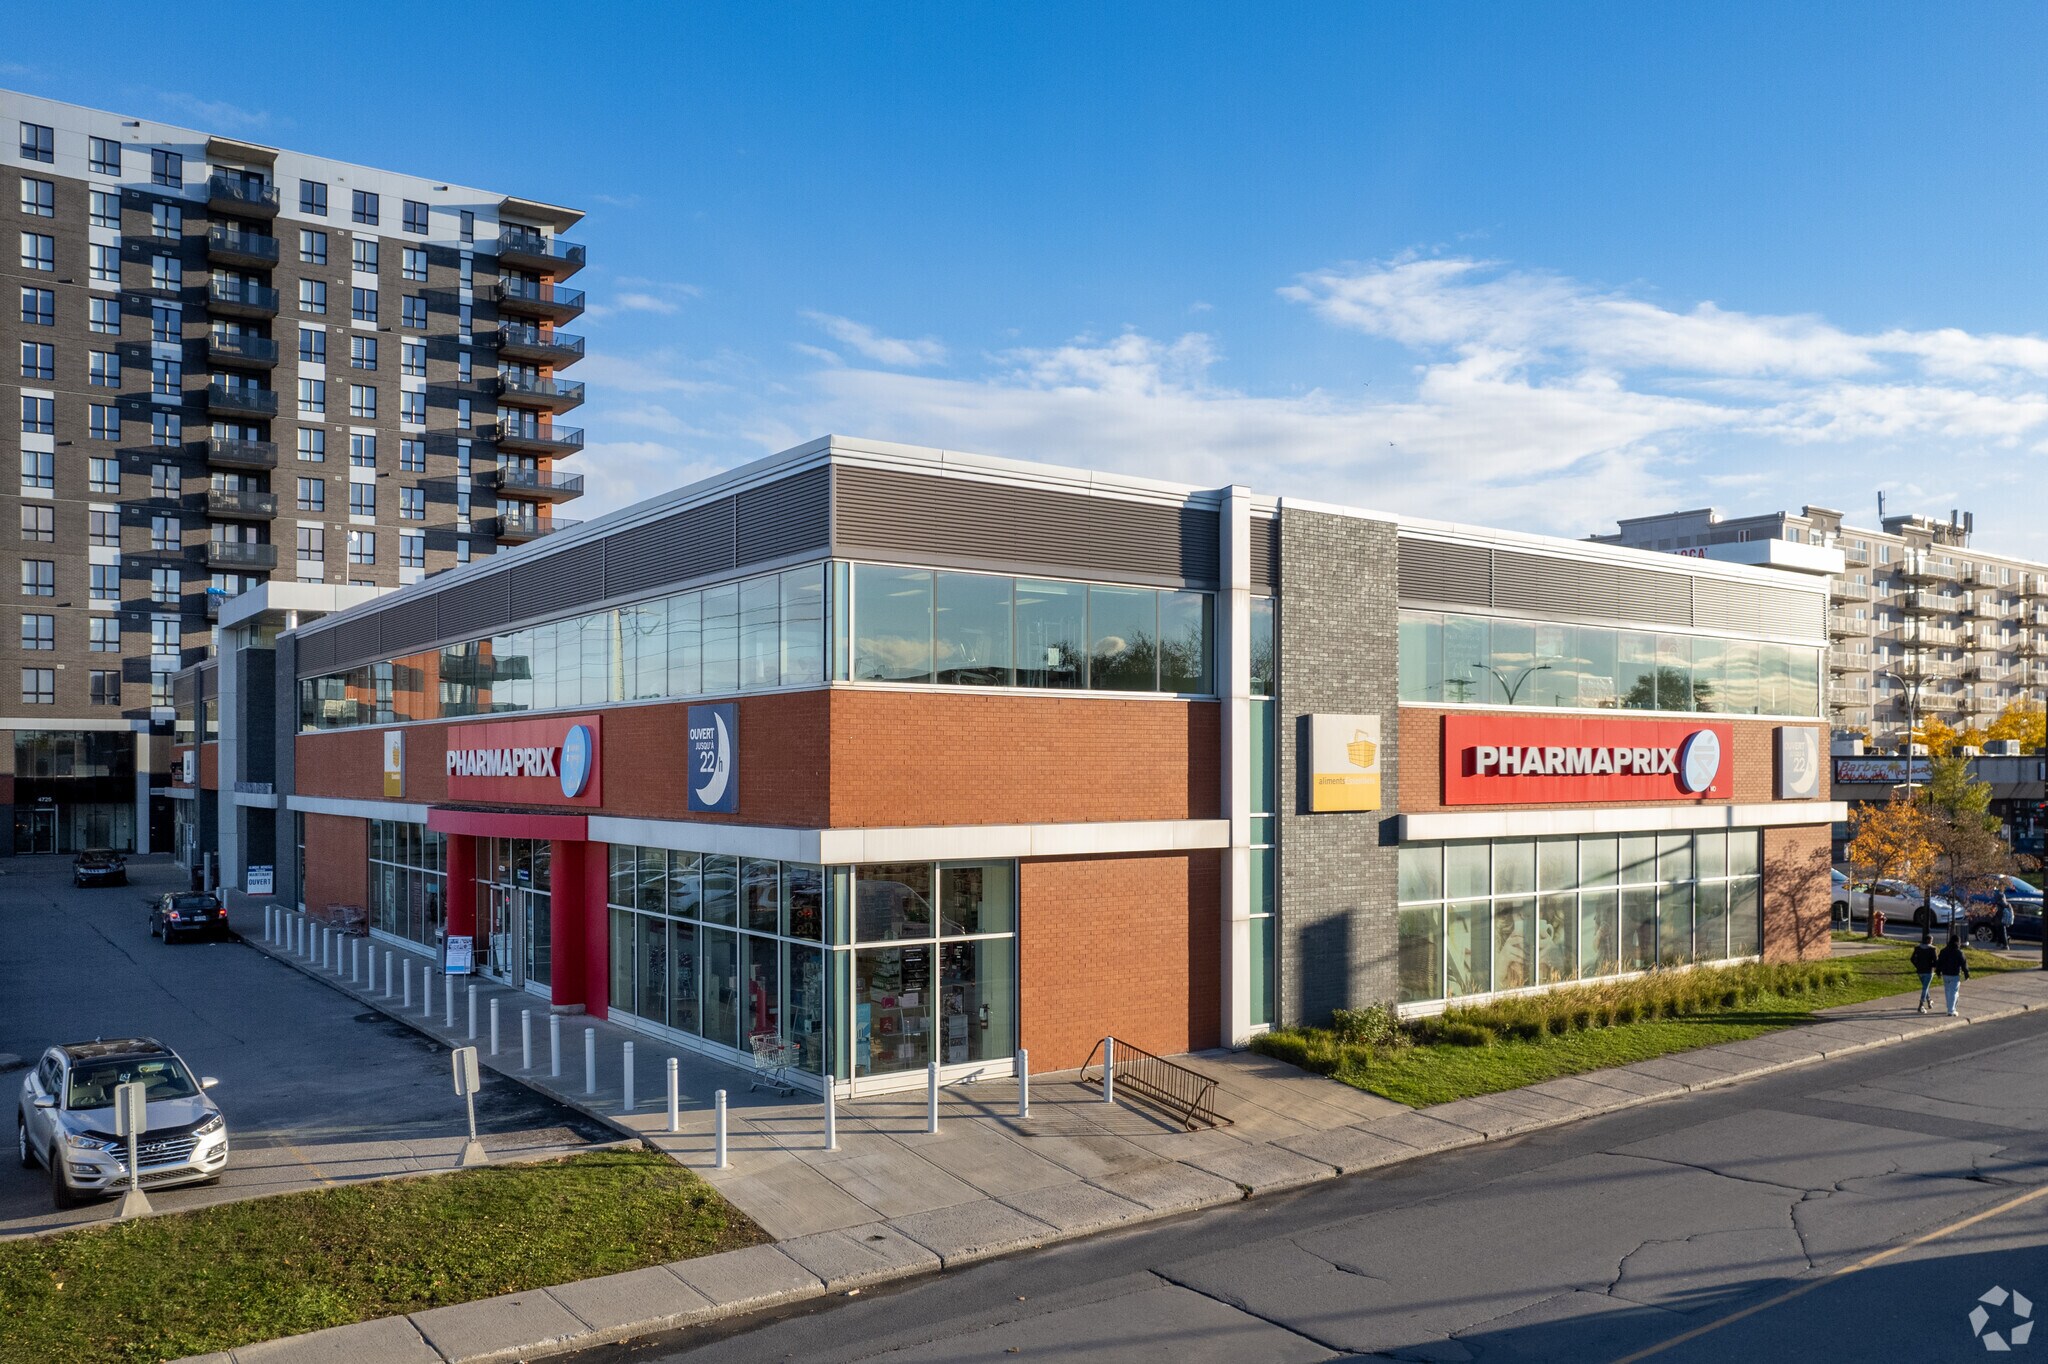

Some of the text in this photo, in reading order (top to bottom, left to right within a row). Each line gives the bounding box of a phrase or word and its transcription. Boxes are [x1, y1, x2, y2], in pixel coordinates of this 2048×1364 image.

[690, 728, 715, 740] OUVERT
[446, 746, 557, 777] PHARMAPRIX
[700, 751, 723, 773] 22 h
[1476, 746, 1679, 774] PHARMAPRIX
[1793, 757, 1806, 772] 22
[1318, 777, 1345, 785] aliments
[249, 878, 271, 886] OUVERT
